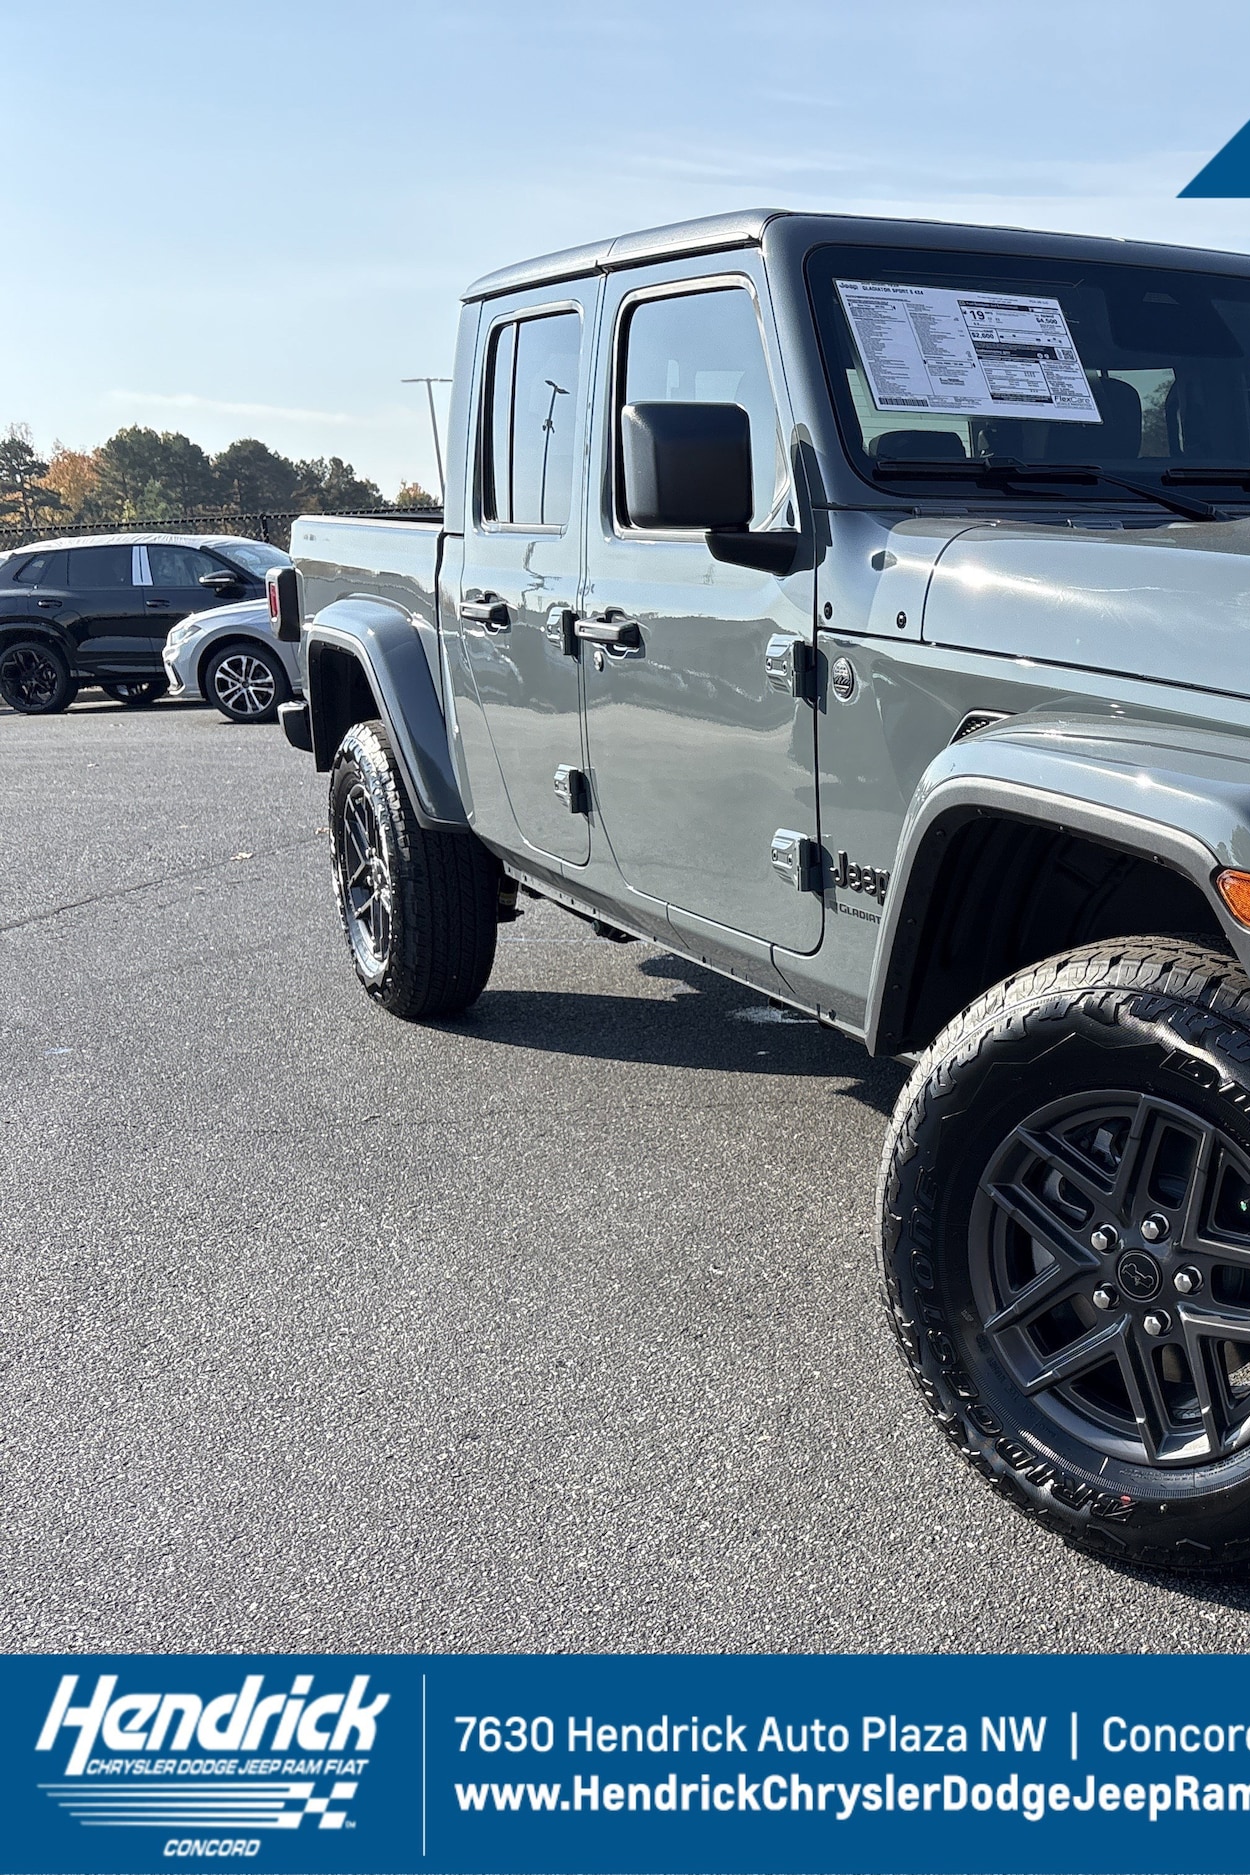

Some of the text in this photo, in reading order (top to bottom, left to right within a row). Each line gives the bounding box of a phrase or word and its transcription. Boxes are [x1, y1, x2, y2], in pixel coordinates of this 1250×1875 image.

[969, 310, 986, 320] 19
[1036, 317, 1058, 325] $4,500
[1054, 395, 1091, 403] FlexCare
[829, 850, 890, 906] Jeep
[908, 1166, 1138, 1523] BRIDGESTONE
